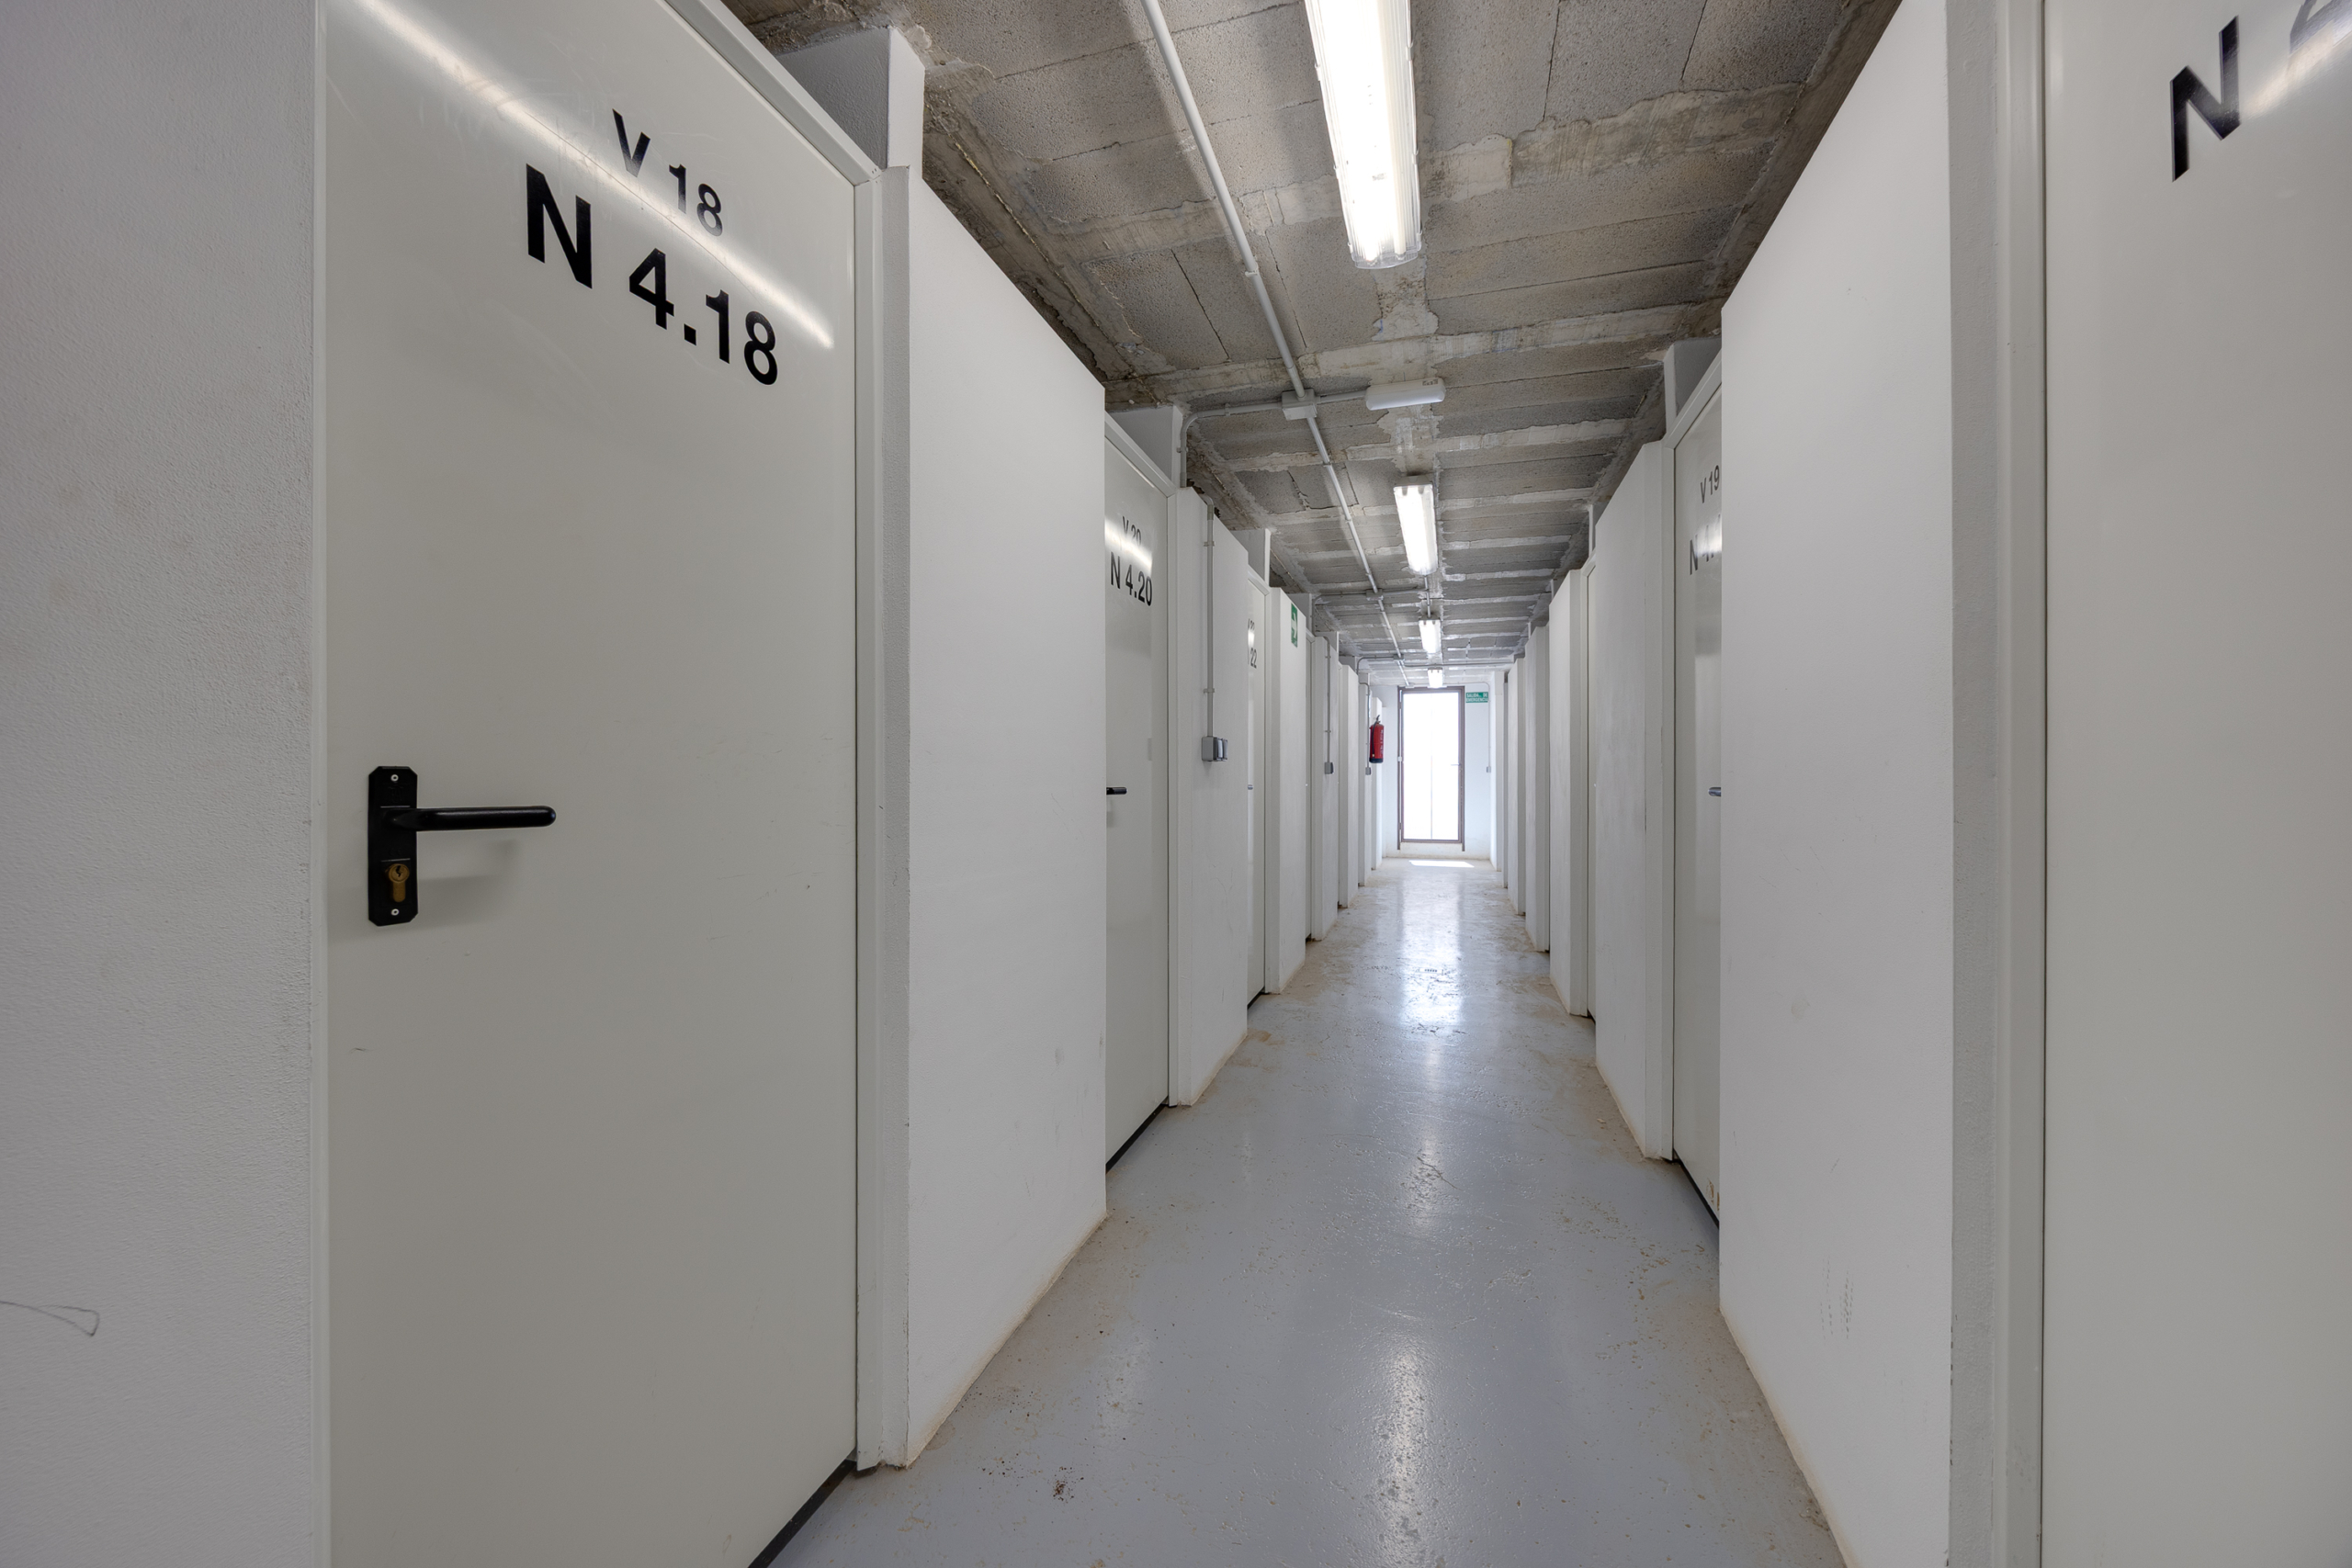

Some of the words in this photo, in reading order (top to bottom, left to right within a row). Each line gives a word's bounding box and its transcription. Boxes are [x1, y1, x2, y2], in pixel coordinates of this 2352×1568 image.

[2170, 15, 2241, 183] N
[612, 108, 650, 177] V
[669, 164, 722, 237] 18
[526, 163, 593, 289] N
[629, 247, 778, 385] 4.18
[1700, 477, 1707, 503] V
[1709, 465, 1720, 495] 19
[1122, 515, 1129, 537] V
[1111, 551, 1121, 589] N
[1125, 564, 1152, 606] 4.20
[1690, 534, 1699, 575] N
